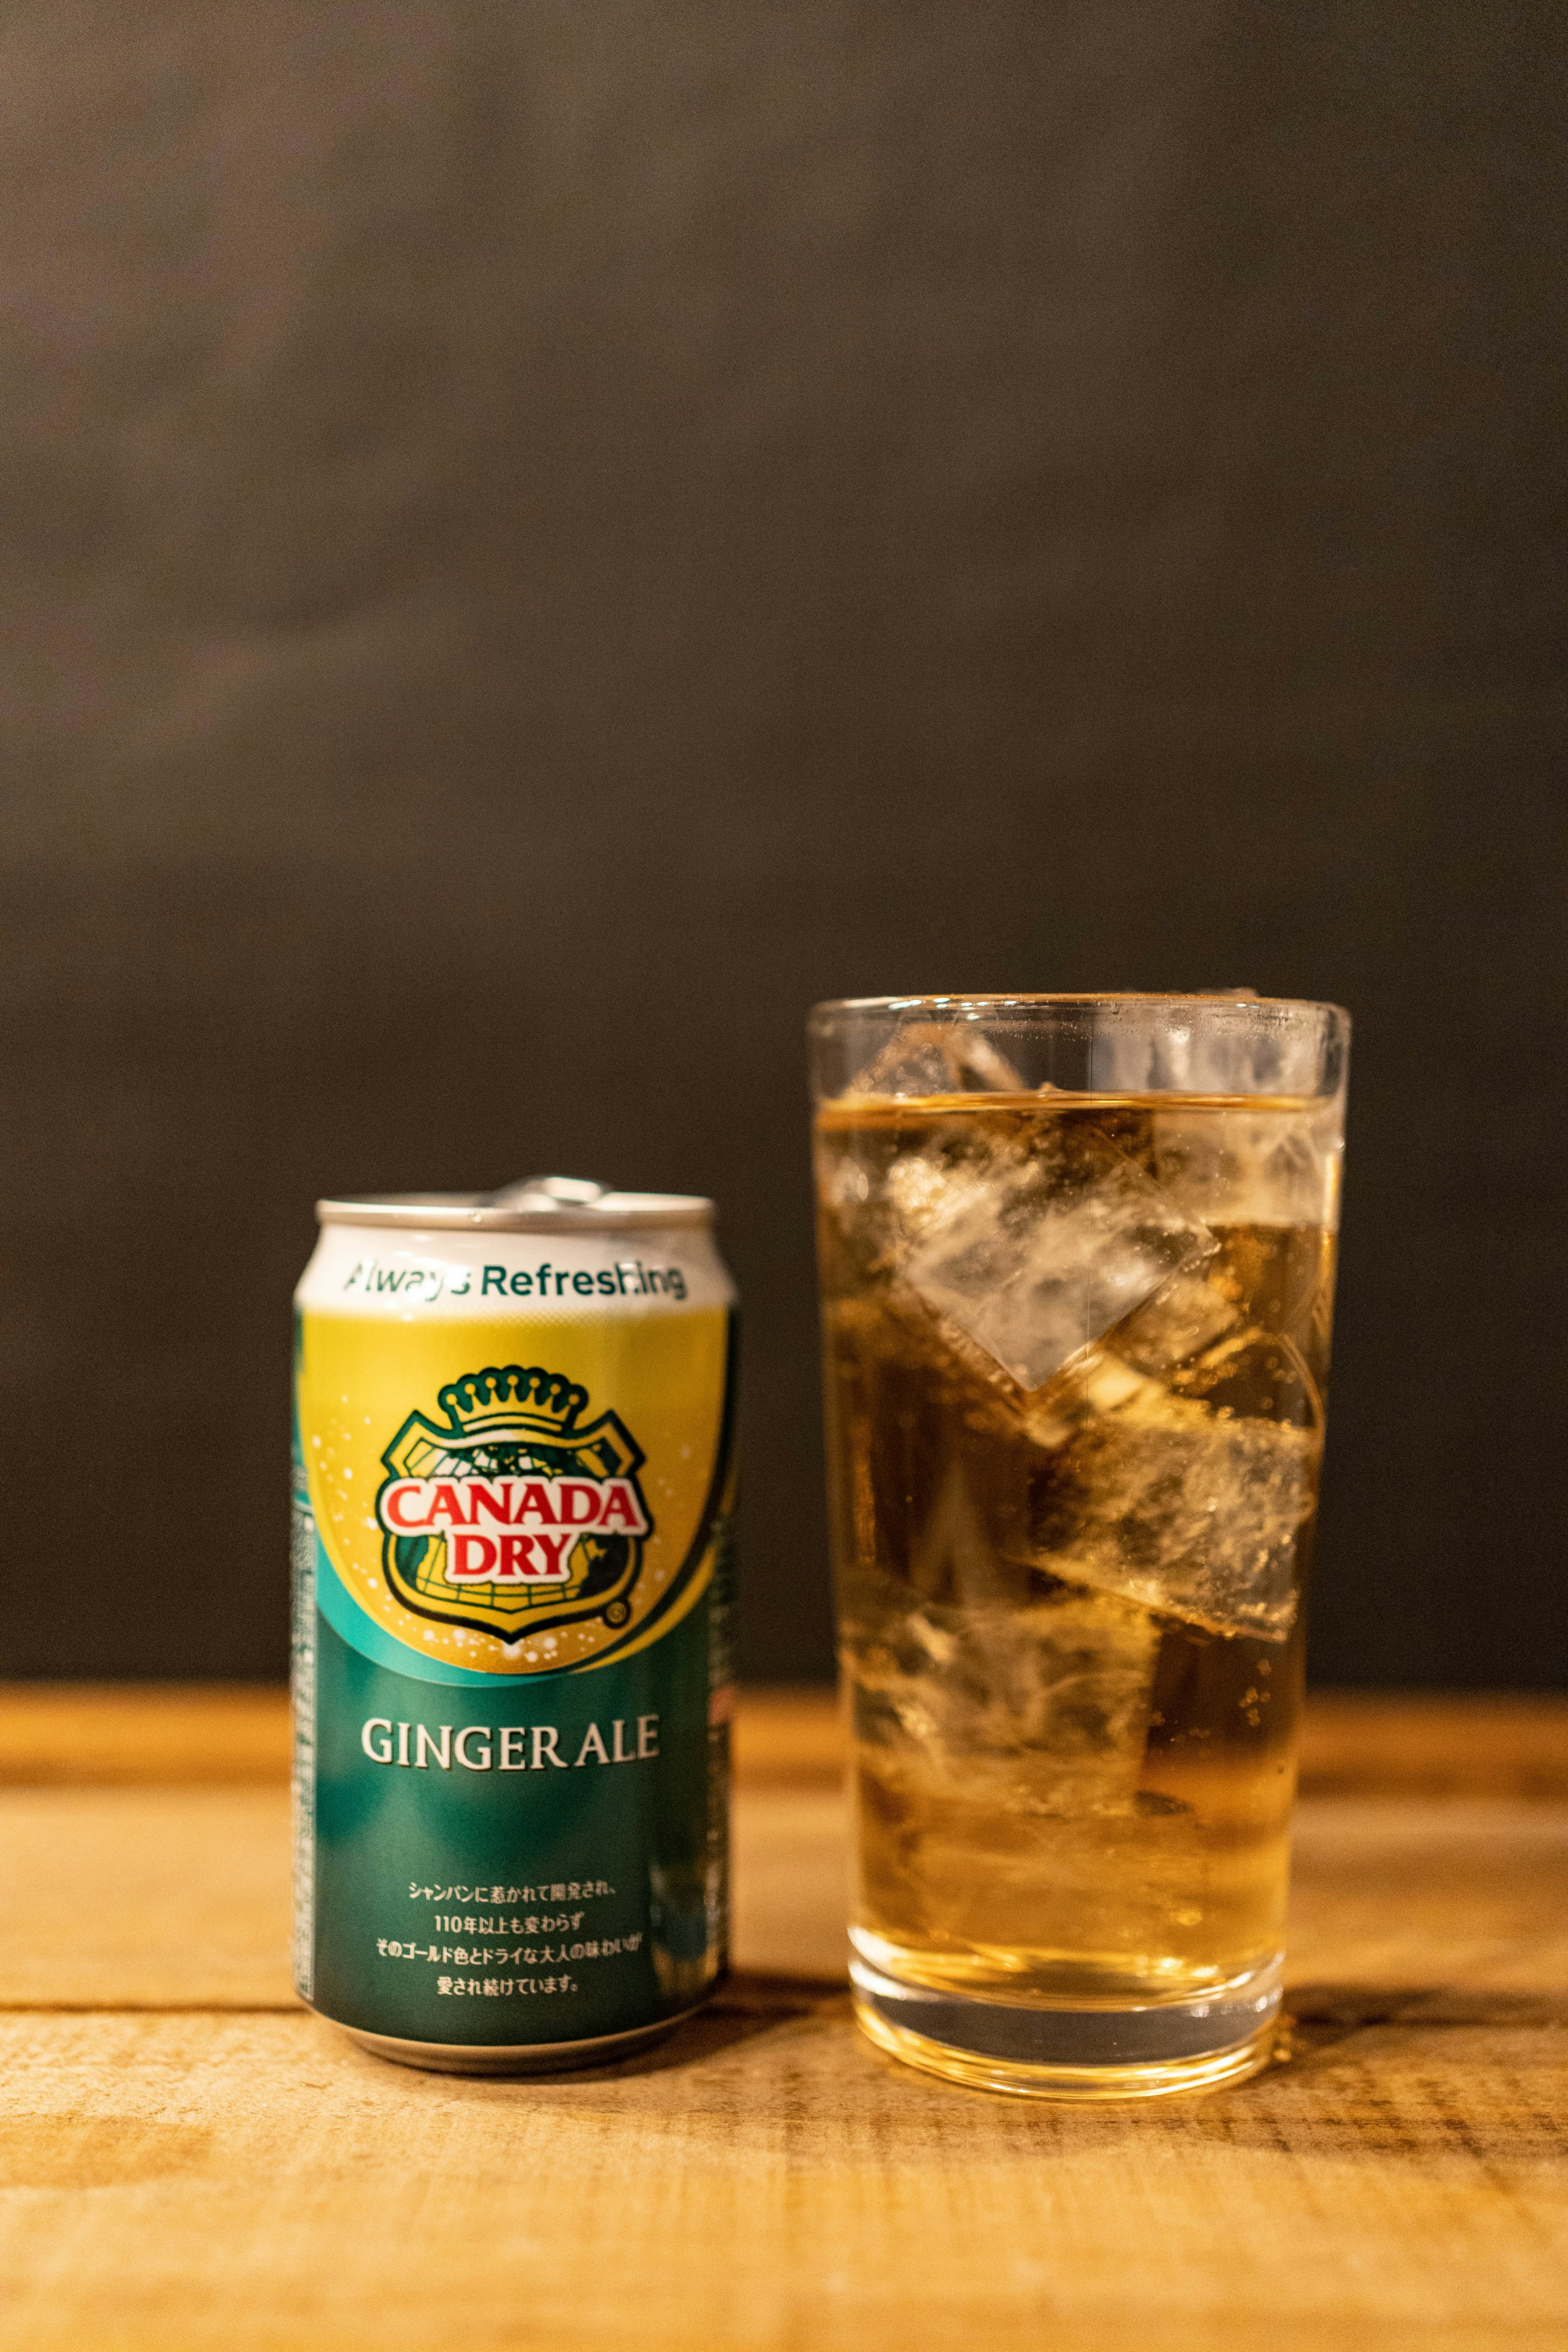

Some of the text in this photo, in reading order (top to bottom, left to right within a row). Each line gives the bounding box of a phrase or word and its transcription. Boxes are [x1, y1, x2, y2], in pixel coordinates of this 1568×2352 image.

[480, 1261, 688, 1300] Refreshing
[387, 1483, 639, 1528] CANADA
[452, 1533, 572, 1577] DRY
[361, 1714, 660, 1769] GINGER ALE
[434, 1911, 585, 1935] 110年以上も変わらず
[376, 1932, 643, 1966] そのゴールド色とドライな大人の味わいが
[437, 1974, 579, 1997] 愛され続けています。
